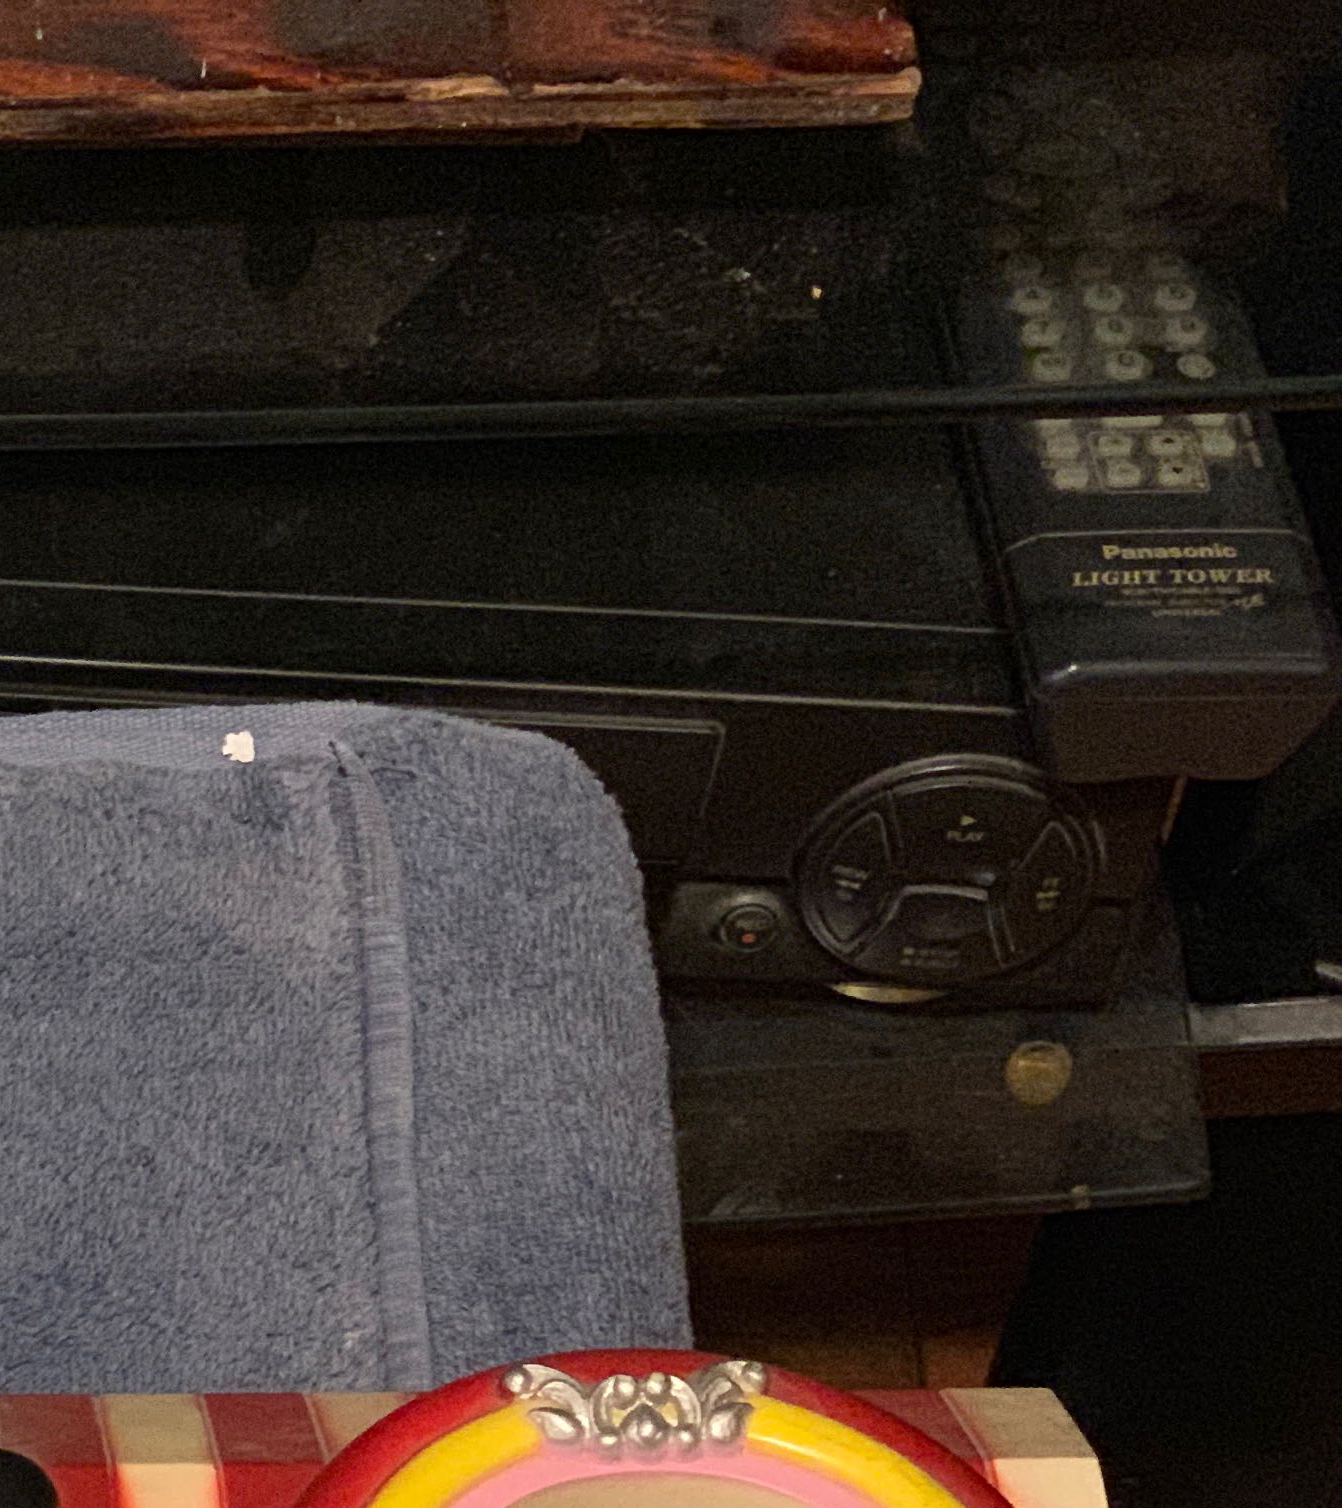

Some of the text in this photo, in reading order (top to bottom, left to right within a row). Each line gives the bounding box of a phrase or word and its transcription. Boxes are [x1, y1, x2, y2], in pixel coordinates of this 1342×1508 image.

[1101, 542, 1238, 560] Panasonic
[1072, 567, 1275, 587] LIGHT TOWER
